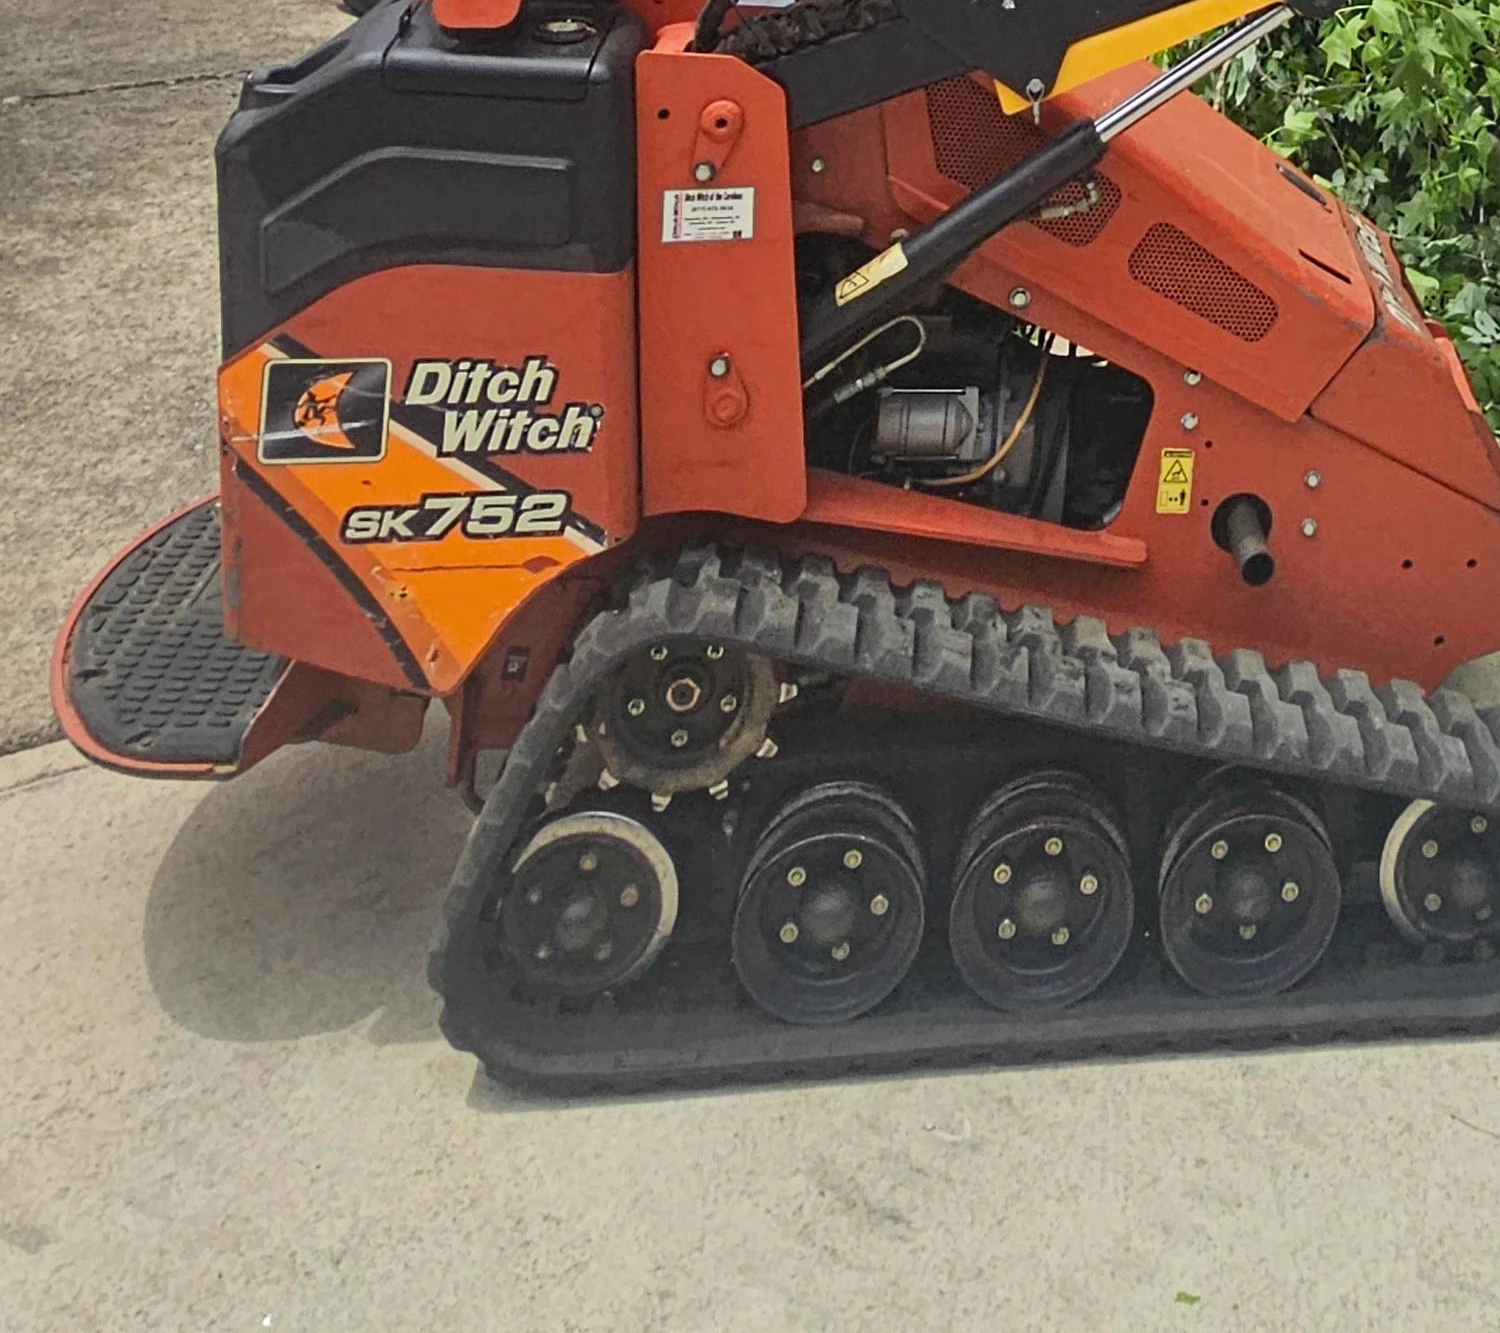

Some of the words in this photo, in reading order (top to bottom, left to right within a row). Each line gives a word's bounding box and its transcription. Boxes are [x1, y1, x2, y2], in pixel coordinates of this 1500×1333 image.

[405, 359, 555, 406] Ditch
[442, 406, 595, 453] Witch
[345, 493, 568, 540] SK752
